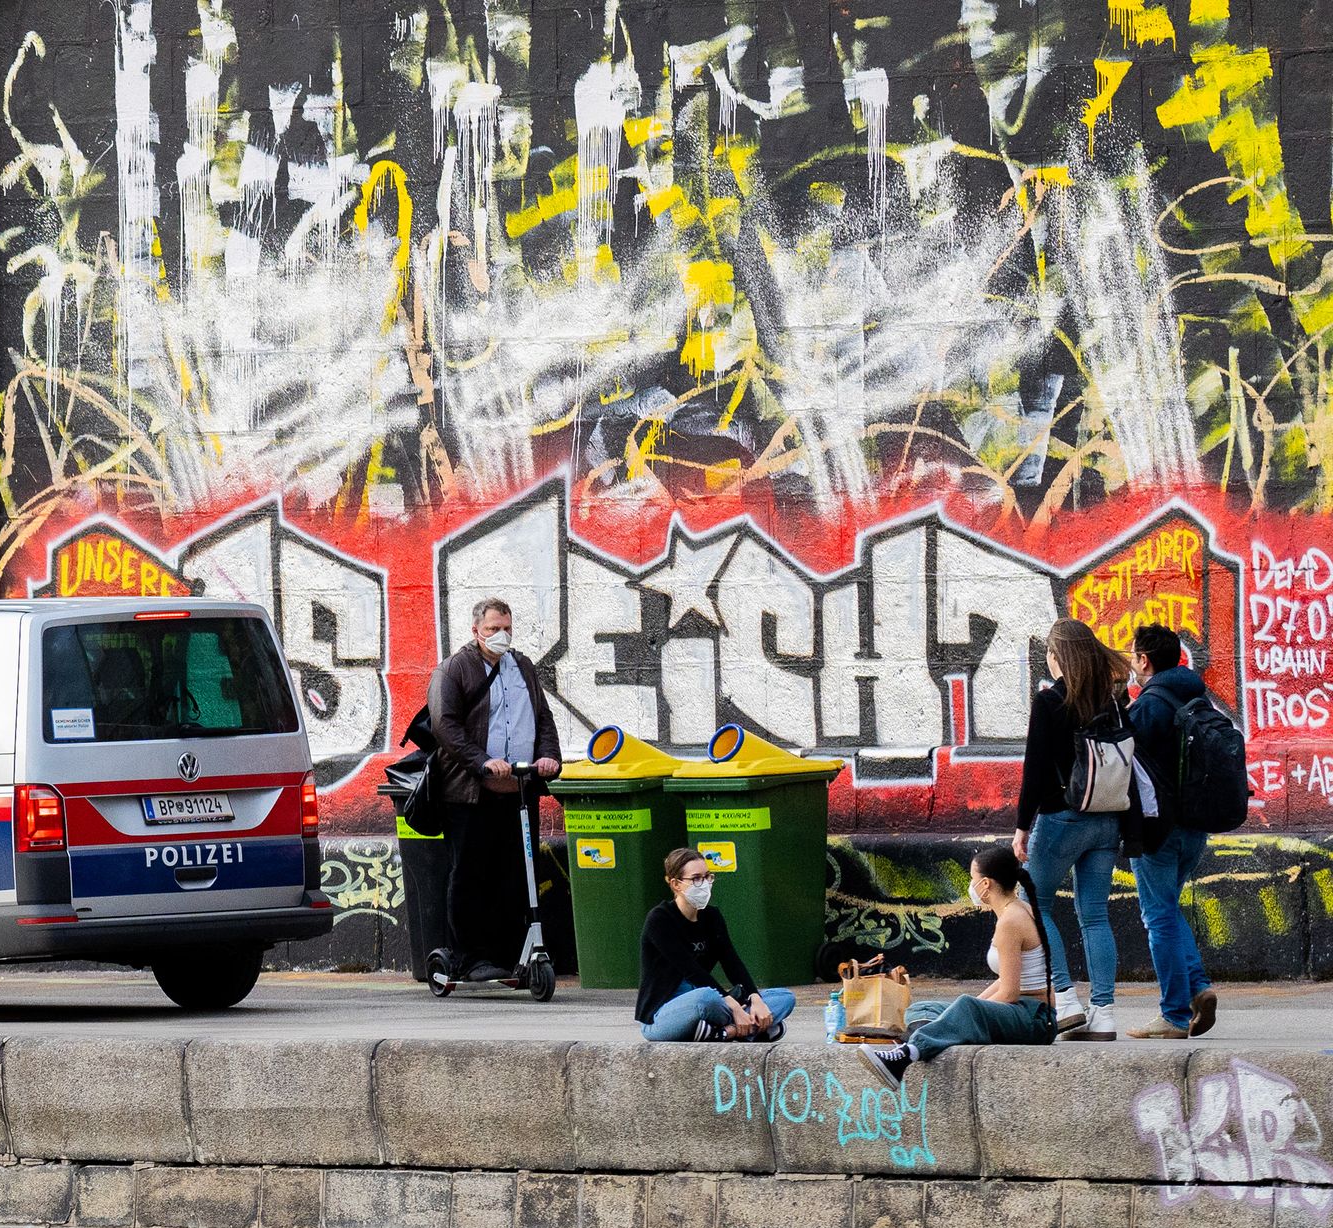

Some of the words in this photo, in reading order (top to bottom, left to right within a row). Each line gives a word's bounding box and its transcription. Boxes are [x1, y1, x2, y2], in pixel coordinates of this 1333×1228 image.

[159, 800, 176, 816] BP
[187, 797, 223, 814] 91124
[145, 843, 244, 867] POLIZEI
